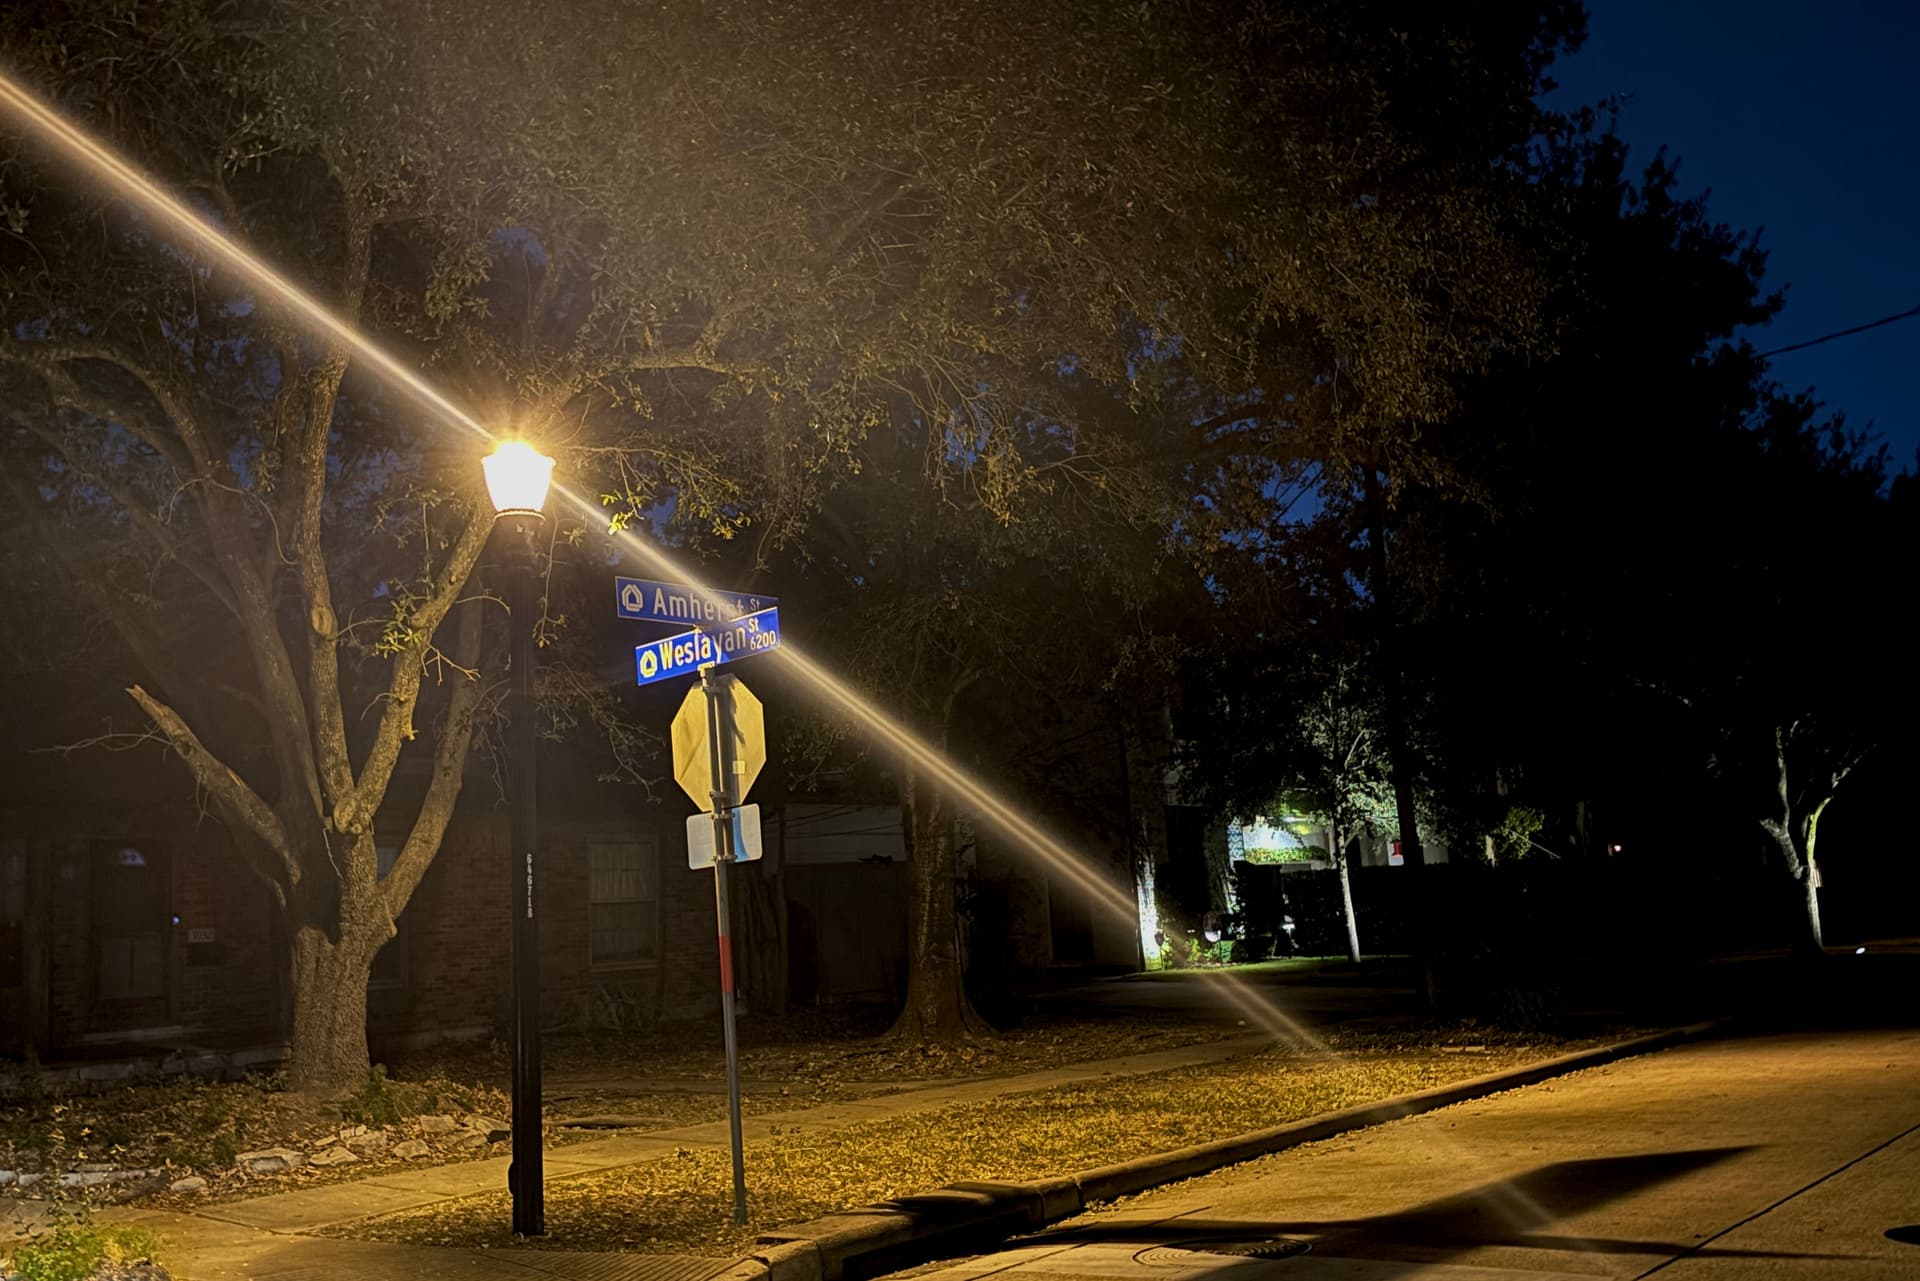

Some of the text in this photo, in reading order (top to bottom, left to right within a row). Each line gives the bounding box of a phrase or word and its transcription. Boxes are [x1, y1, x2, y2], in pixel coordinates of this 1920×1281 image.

[659, 617, 760, 670] Weslayan St
[750, 630, 777, 651] 6200
